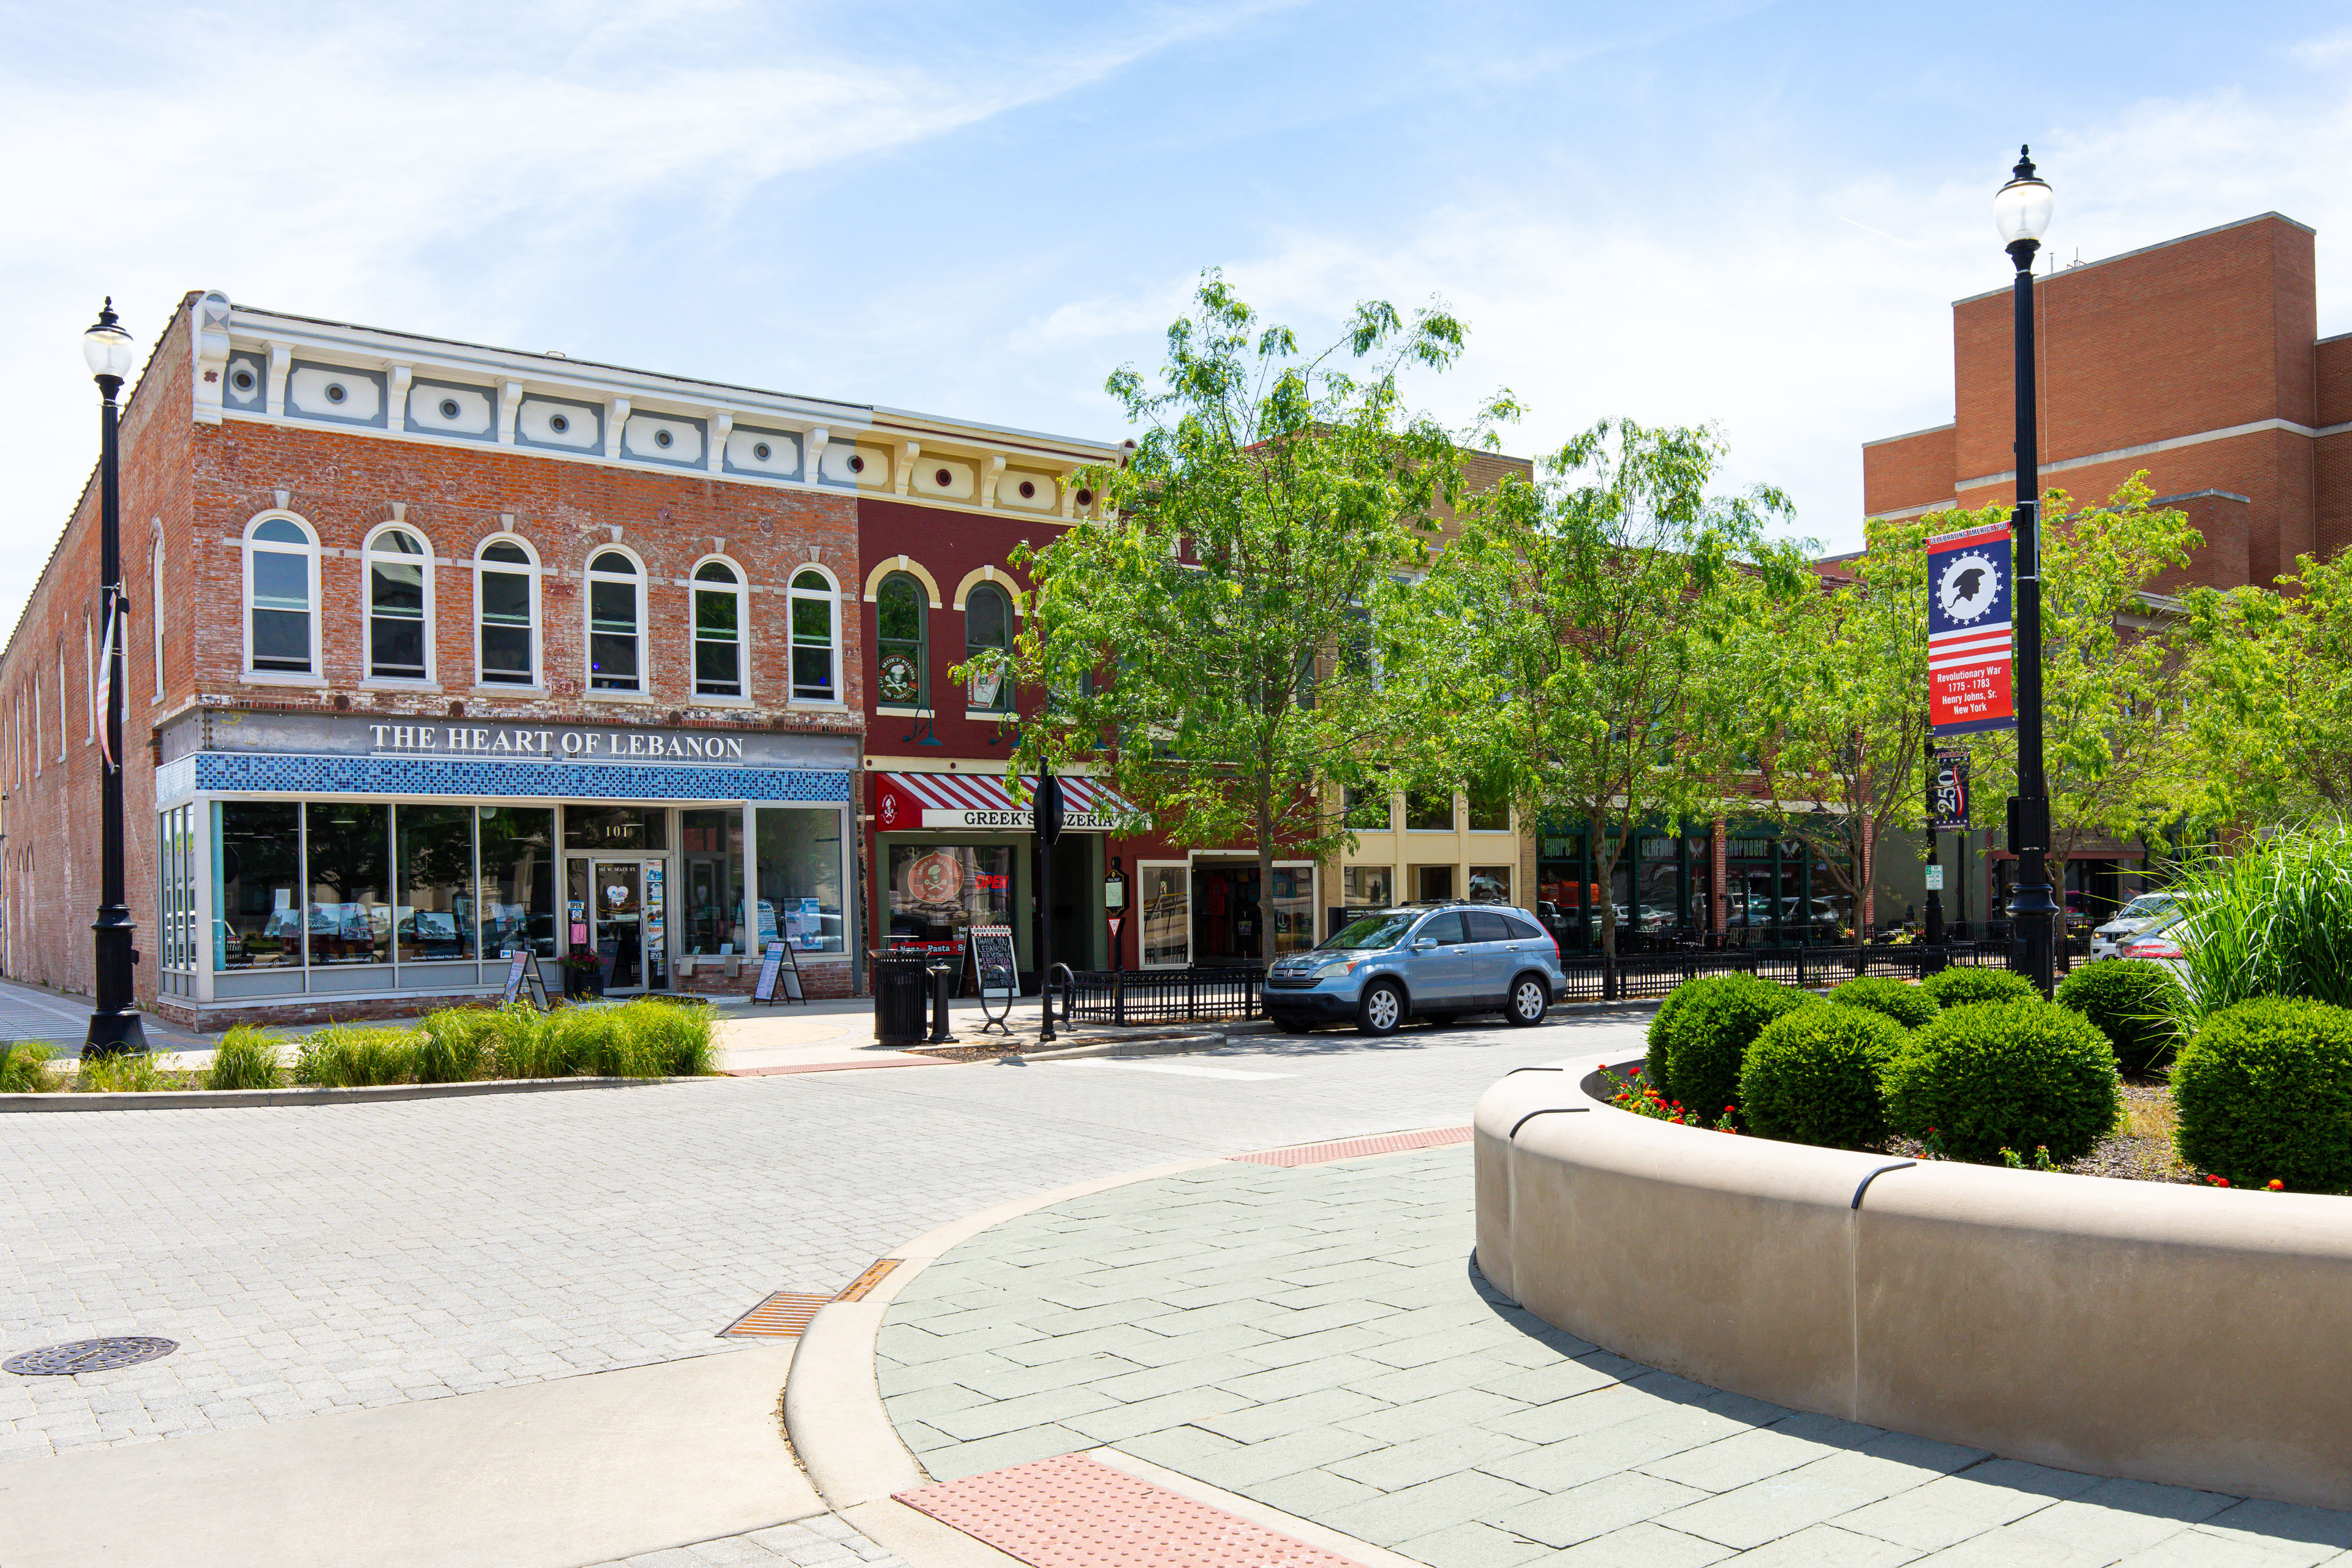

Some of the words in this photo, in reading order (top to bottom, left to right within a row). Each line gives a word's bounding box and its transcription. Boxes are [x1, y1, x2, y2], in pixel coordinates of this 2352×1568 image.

[1929, 531, 1967, 545] CELEBRATING
[1968, 526, 1995, 537] AMERICA
[1996, 522, 2007, 531] 250
[1937, 669, 1985, 682] Revolutionary
[1986, 666, 2002, 675] War
[1948, 682, 1965, 692] 1775
[1973, 678, 1990, 689] 1783
[1942, 695, 1962, 704] Henry
[1964, 692, 1986, 702] Johns,
[1988, 690, 1997, 699] Sr.
[1954, 705, 1969, 715] New
[1970, 702, 1987, 712] York
[369, 725, 436, 748] THE
[446, 728, 553, 752] HEART
[561, 732, 600, 753] OF
[609, 734, 744, 758] LEBANON
[1937, 770, 1956, 813] 250
[965, 812, 1034, 825] GREEK'S
[606, 826, 627, 837] 101
[1544, 838, 1570, 858] CHOPS
[1642, 839, 1673, 858] SEAFOOD
[975, 875, 1009, 889] OPEN
[975, 937, 995, 945] THANK
[995, 937, 1008, 946] YOU
